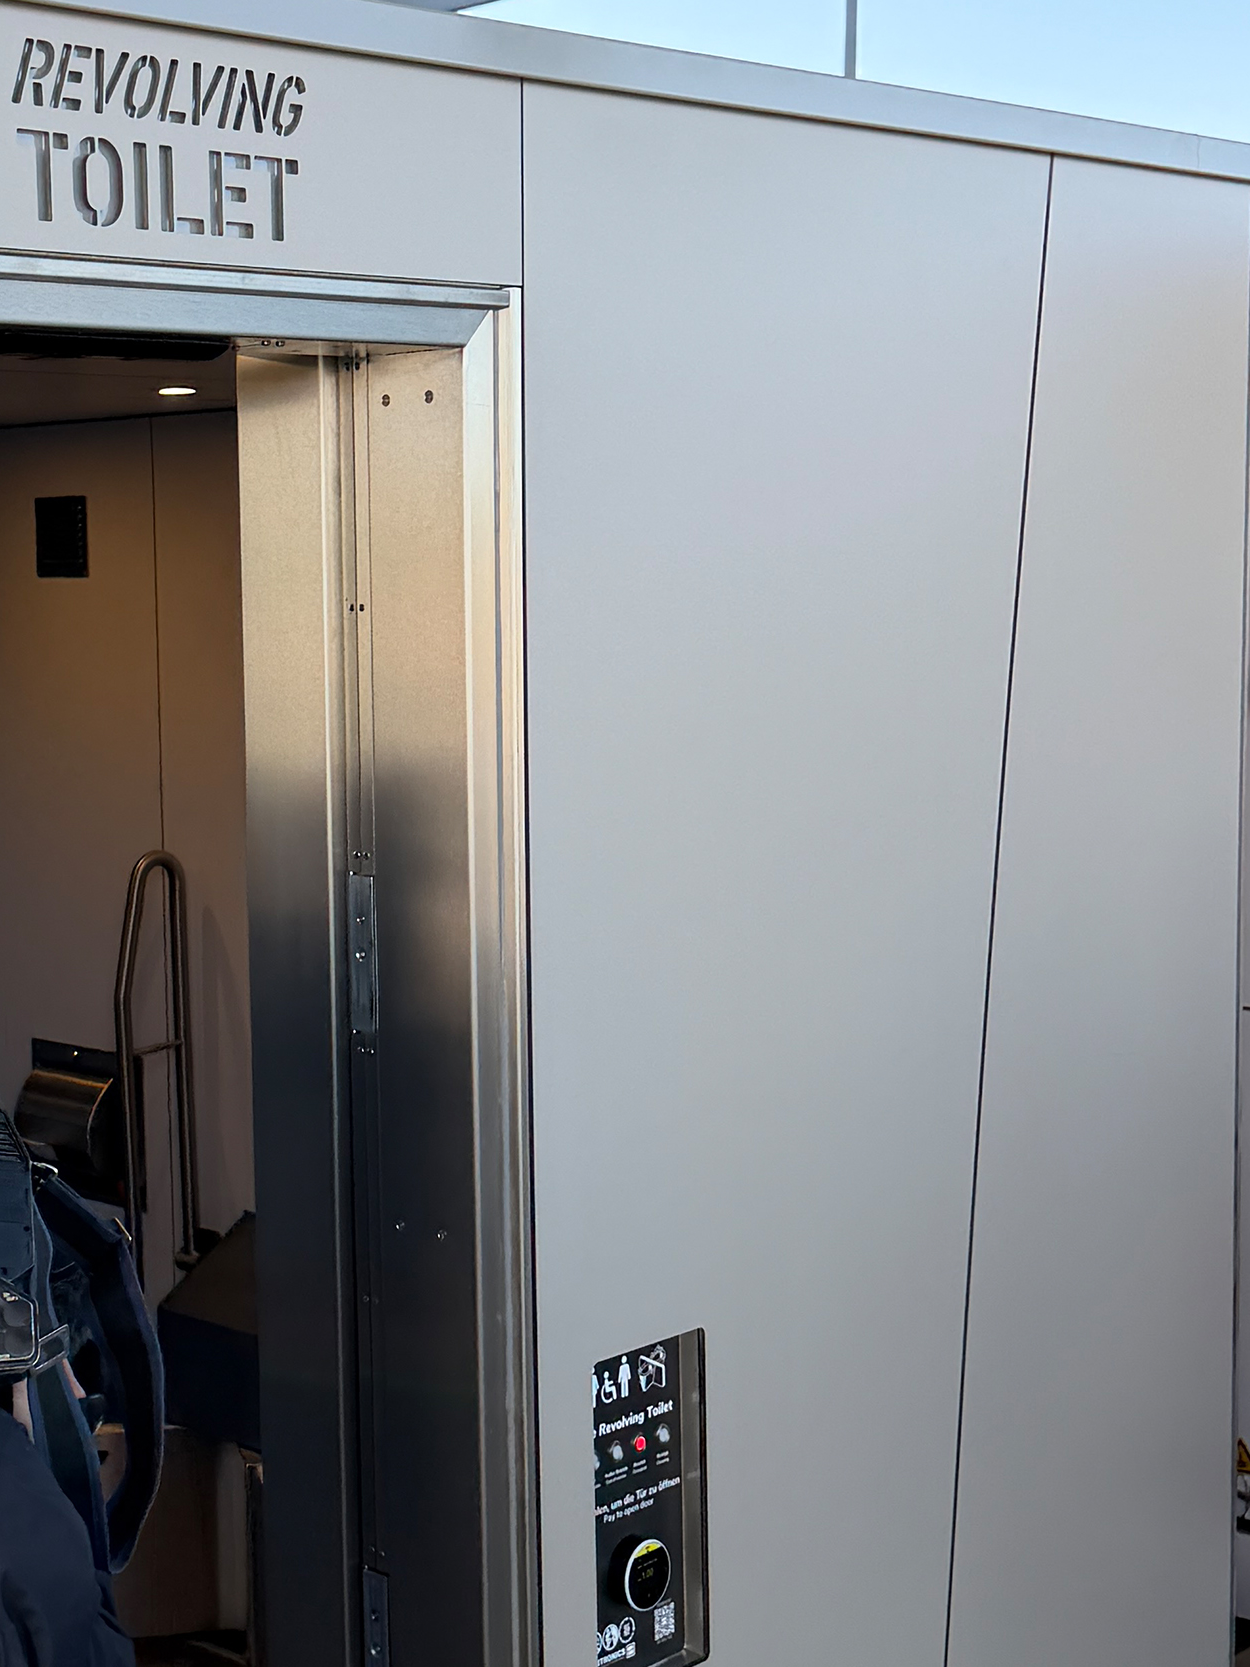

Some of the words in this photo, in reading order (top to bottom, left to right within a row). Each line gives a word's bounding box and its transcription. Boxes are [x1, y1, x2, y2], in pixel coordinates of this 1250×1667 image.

[11, 38, 306, 137] REVOLVING
[16, 128, 299, 241] TOILET
[599, 1412, 645, 1436] Revolving
[646, 1400, 673, 1418] Toilet
[604, 1514, 615, 1523] Pay
[616, 1510, 623, 1518] to
[623, 1504, 639, 1516] open
[640, 1498, 654, 1509] door
[611, 1499, 623, 1510] um
[623, 1494, 635, 1504] die
[636, 1488, 647, 1500] Tür
[648, 1486, 657, 1495] zu
[658, 1477, 680, 1491] öffnen
